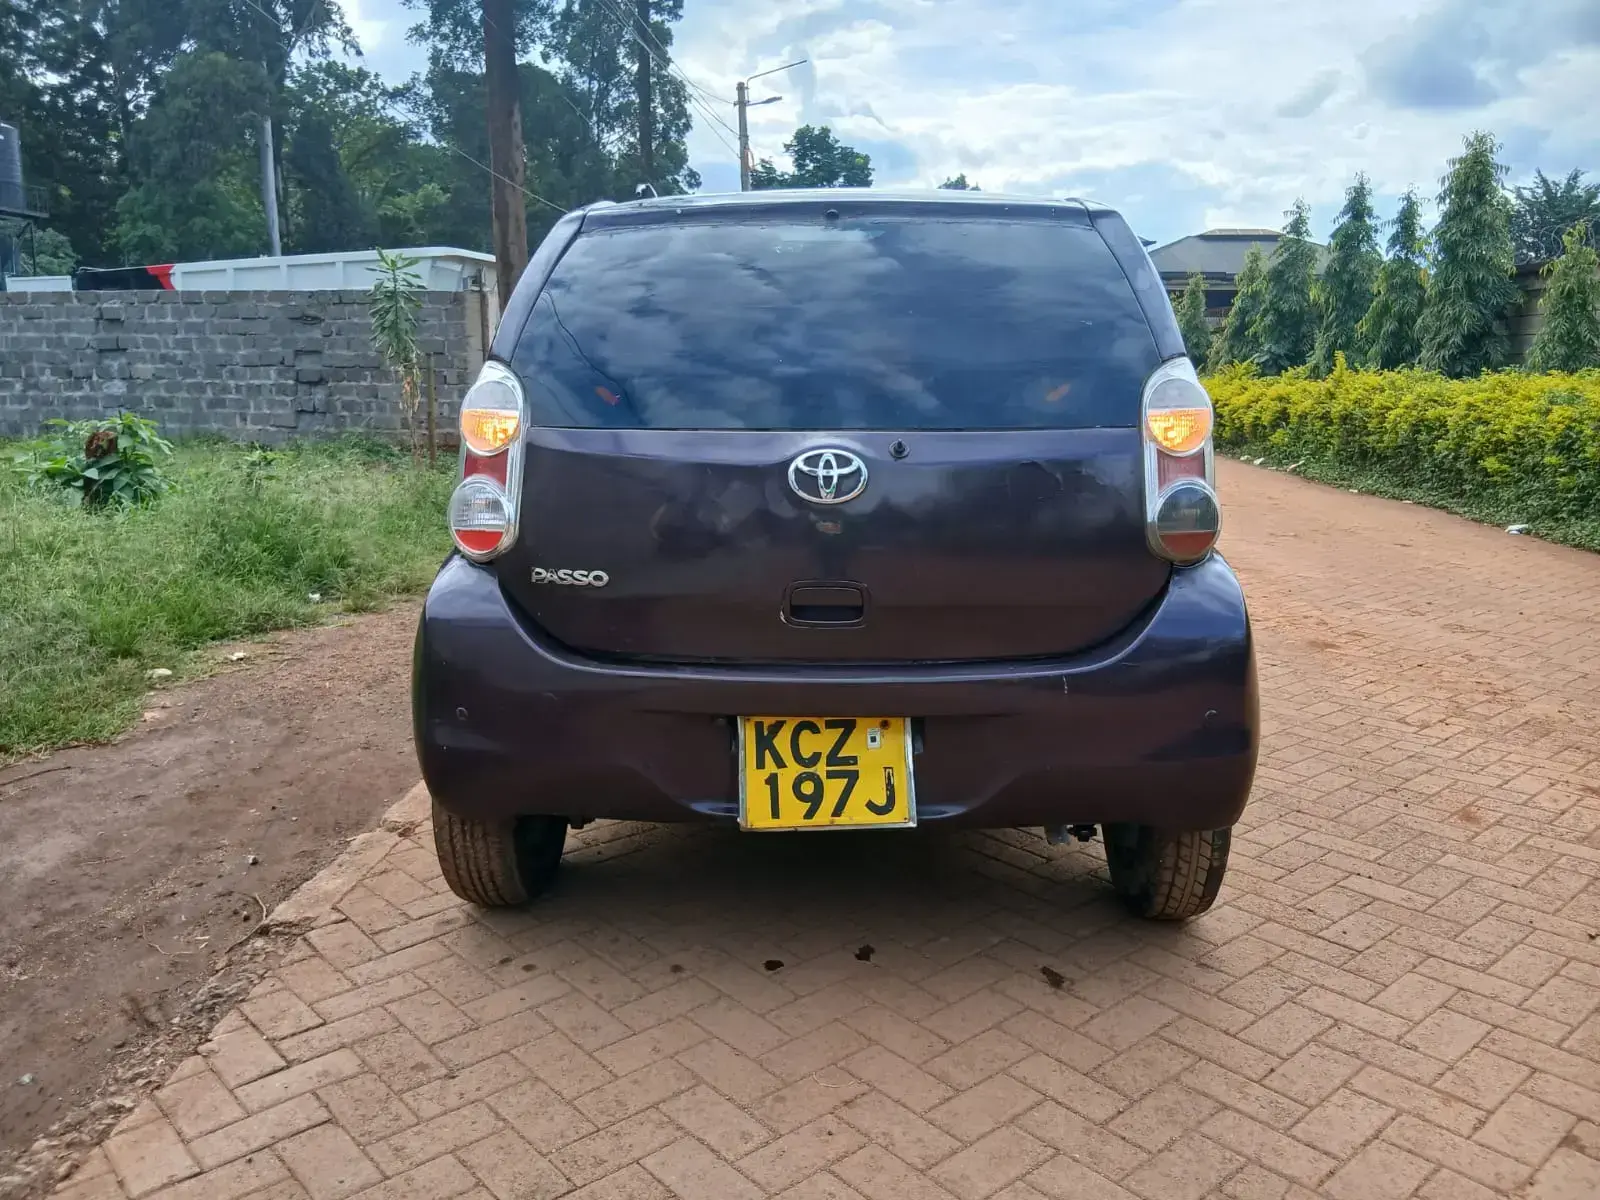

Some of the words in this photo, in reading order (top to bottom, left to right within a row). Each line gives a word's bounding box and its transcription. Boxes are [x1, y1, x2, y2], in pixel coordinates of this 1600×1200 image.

[531, 566, 609, 587] PASSO
[754, 719, 858, 770] KCZ
[764, 767, 896, 820] 197J
